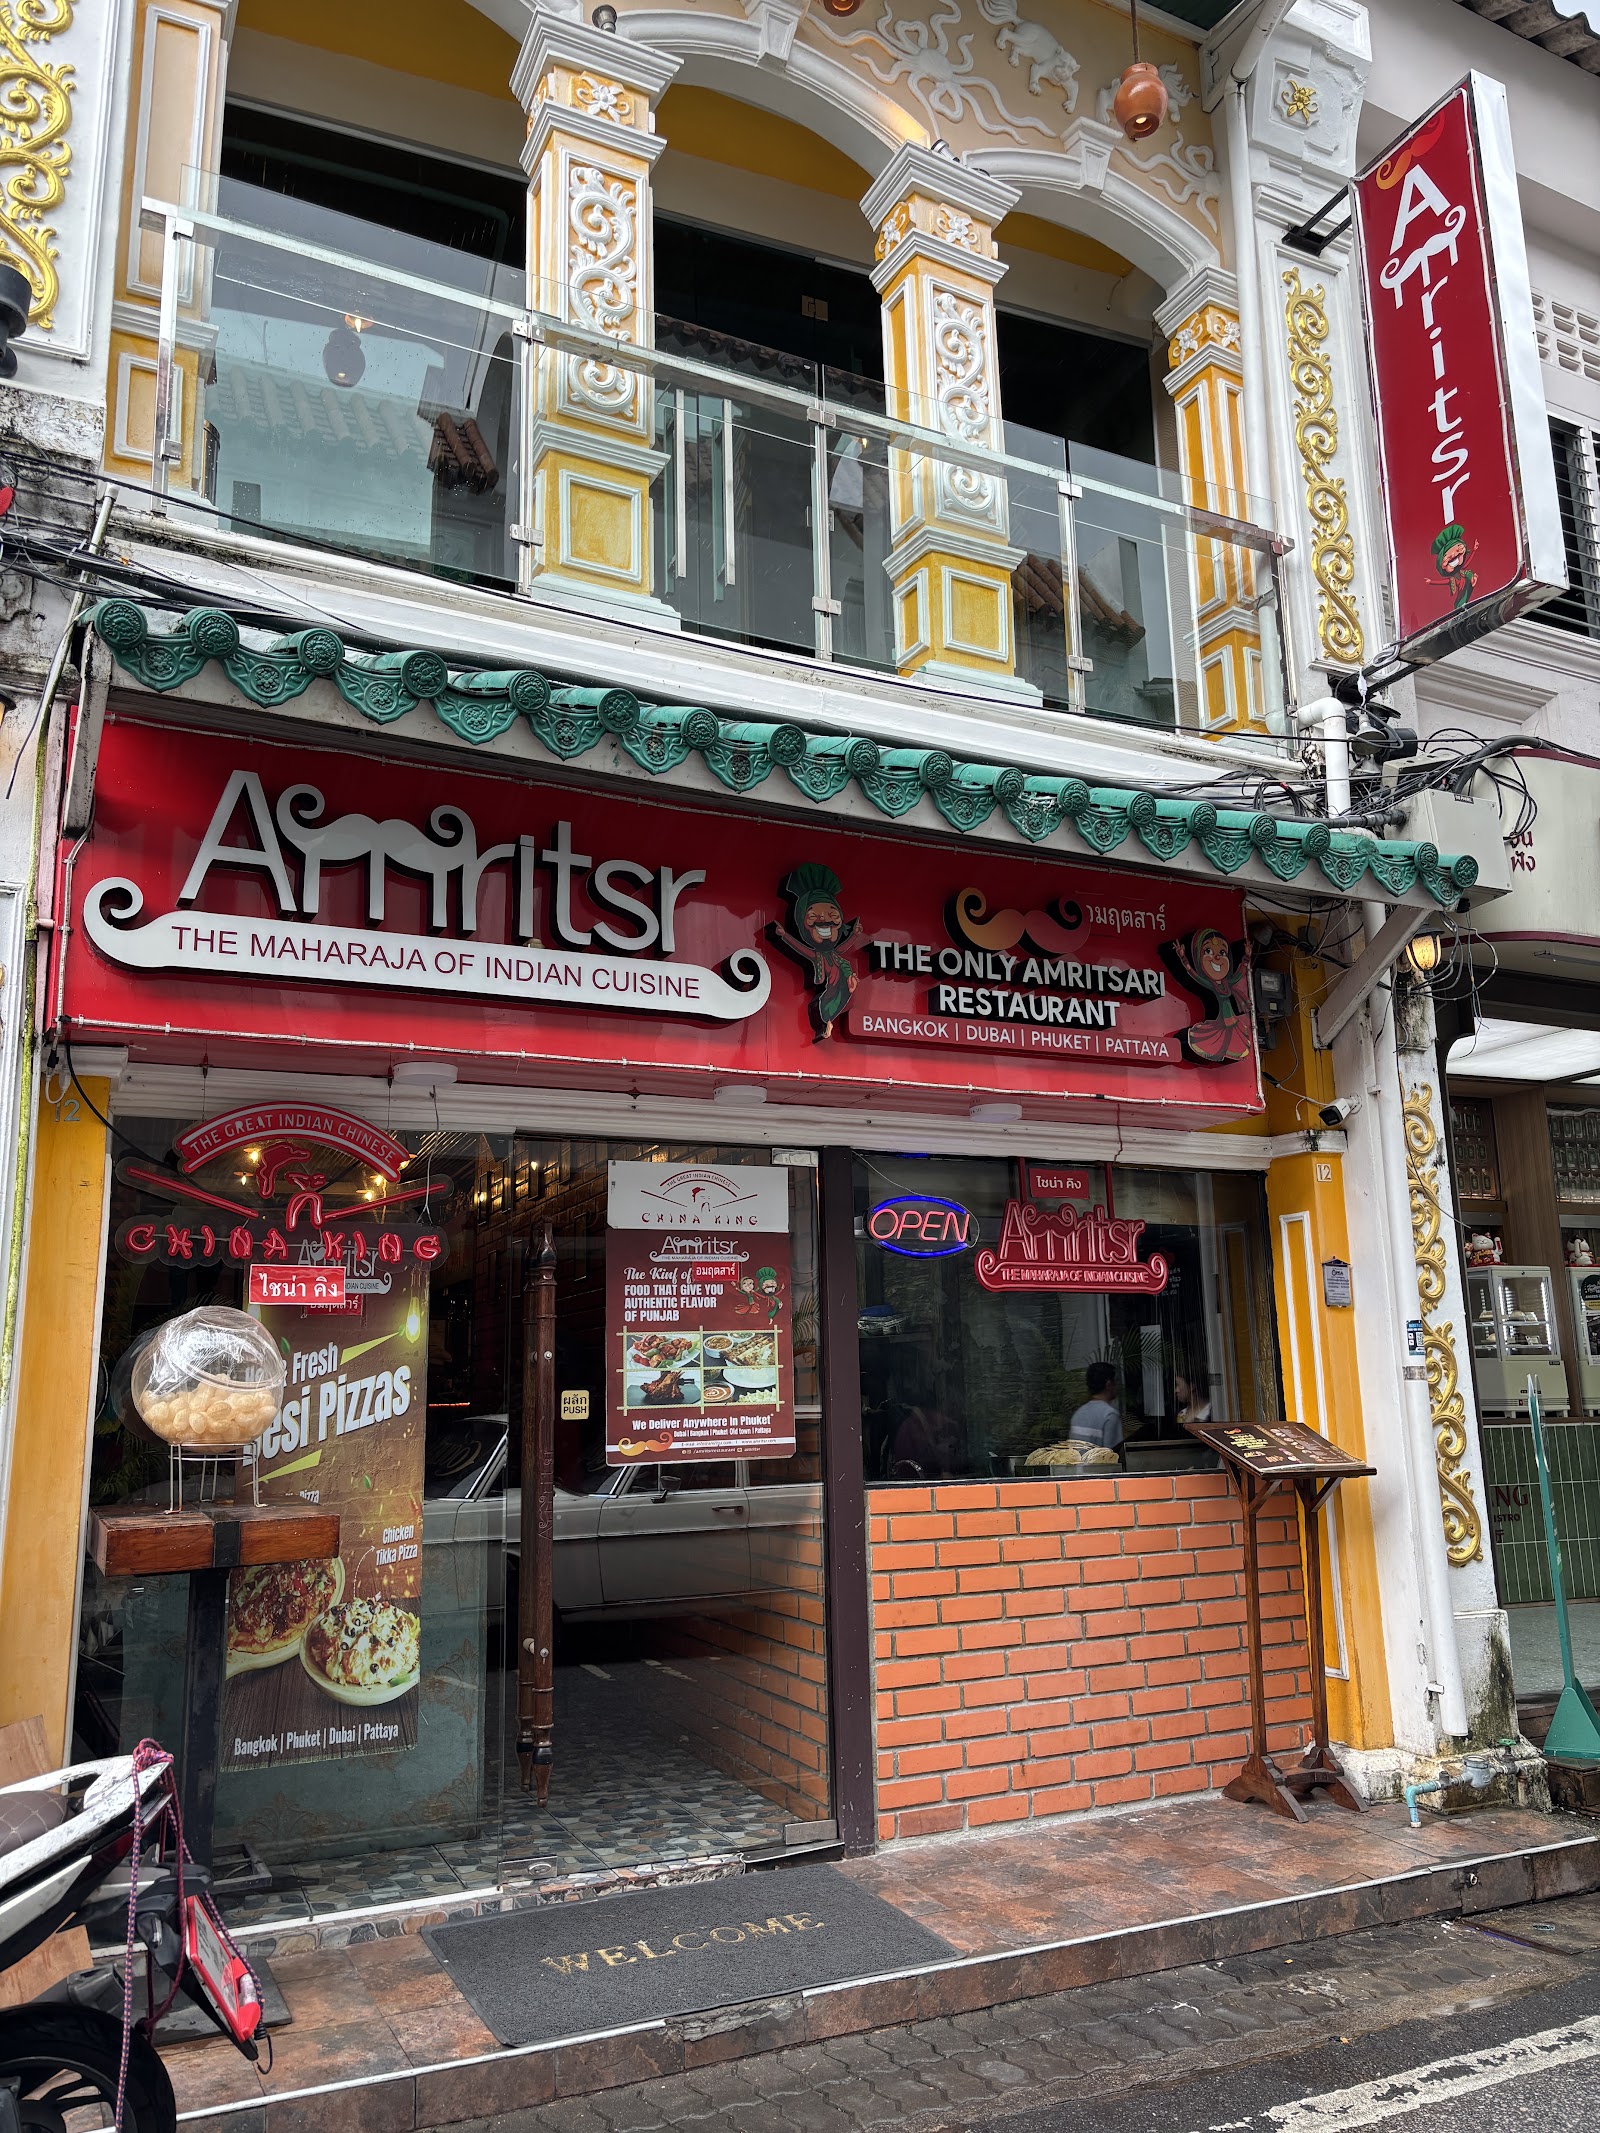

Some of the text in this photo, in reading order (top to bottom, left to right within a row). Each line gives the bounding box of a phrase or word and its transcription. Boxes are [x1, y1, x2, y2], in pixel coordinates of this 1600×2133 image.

[1379, 163, 1471, 526] Amritsr
[178, 769, 708, 953] Amritsr
[171, 925, 700, 1000] THE MAHARAJA OF INDIAN CUISINE
[873, 940, 1166, 997] THE ONLY AMRITSARI
[939, 985, 1121, 1027] RESTAURANT
[862, 1015, 1170, 1058] BANGKOK DUBAI PHUKET PATTAYA
[189, 1113, 397, 1164] THE GREAT INDIAN CHINESE
[666, 1172, 732, 1188] THE GREAT INDIAN CHINESE
[1036, 1175, 1082, 1190] ไชน่า คิง
[1317, 1164, 1332, 1181] 12
[641, 1212, 758, 1226] CHINA KING
[869, 1208, 970, 1242] OPEN
[1000, 1199, 1146, 1265] Amritsr
[125, 1224, 441, 1263] CHINA KING
[661, 1235, 739, 1255] Amritsr
[624, 1267, 646, 1281] The
[680, 1267, 693, 1284] of
[695, 1262, 736, 1279] อมฤตสาร์
[1000, 1268, 1021, 1281] THE
[1020, 1269, 1070, 1282] MAHARAJA
[1069, 1270, 1083, 1281] OF
[1083, 1270, 1112, 1283] INDIAN
[258, 1272, 339, 1298] ไชน่า คิง
[359, 1282, 380, 1290] CUISINE
[624, 1283, 724, 1296] FOOD THAT GIVE YOU
[624, 1296, 717, 1309] AUTHENTIC FLAVOR
[624, 1309, 680, 1322] OF PUNJAB
[292, 1341, 339, 1385] Fresh
[563, 1393, 587, 1405] ผลัก
[563, 1405, 587, 1414] PUSH
[242, 1365, 412, 1467] esi Pizzas
[632, 1420, 647, 1431] We
[648, 1418, 681, 1430] Deliver
[682, 1416, 728, 1429] Anywhere
[729, 1416, 739, 1426] In
[673, 1430, 687, 1438] Dubai
[712, 1428, 729, 1436] Phuket
[1491, 1485, 1529, 1507] NG
[1493, 1513, 1521, 1523] ISTRO
[382, 1523, 414, 1545] Chicken
[375, 1544, 418, 1567] Tikka Pizza
[234, 1722, 399, 1757] Bangkok Phuket Dubai Pattaya
[540, 1911, 825, 1975] WELCOME
